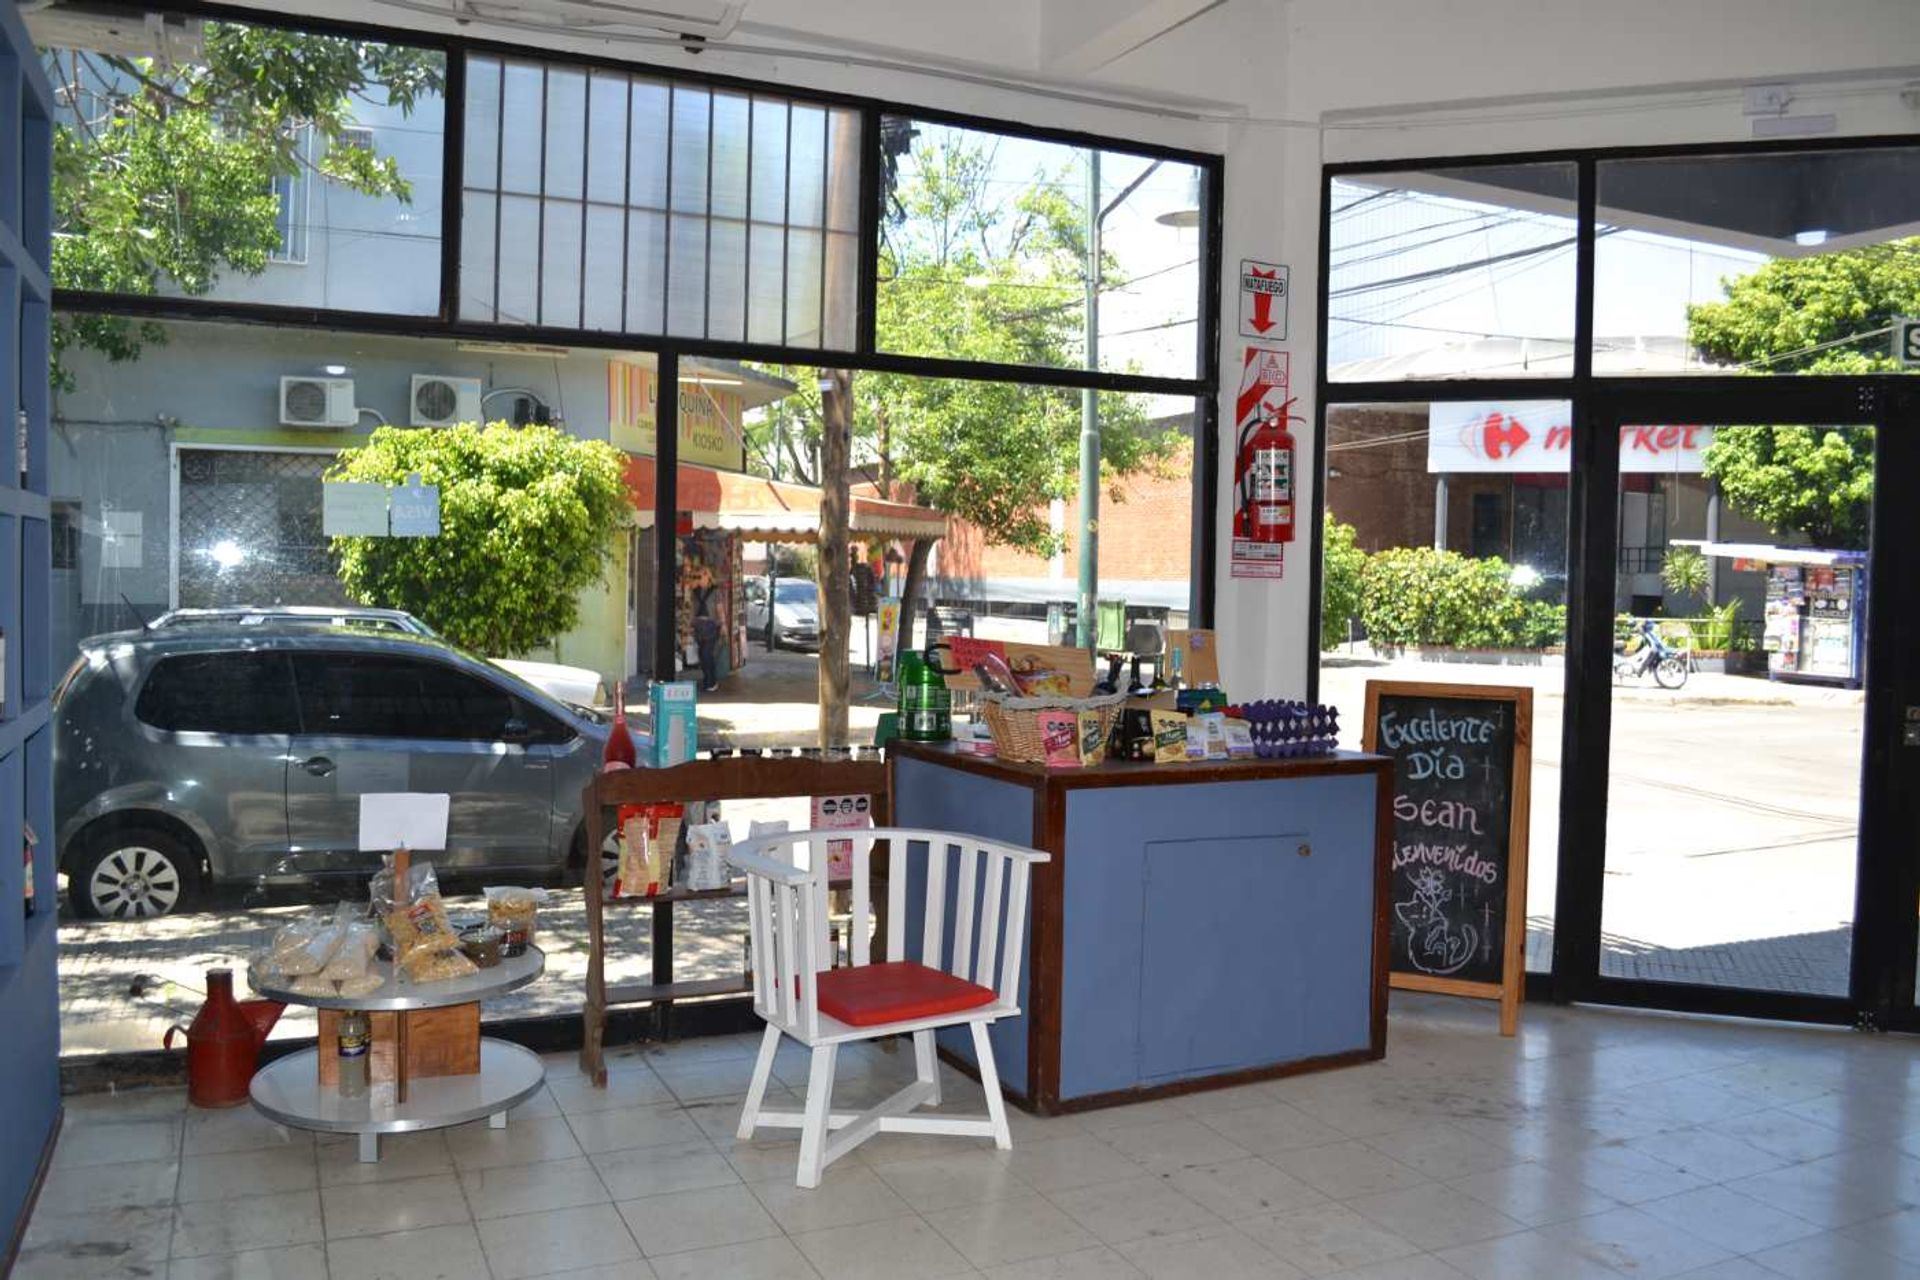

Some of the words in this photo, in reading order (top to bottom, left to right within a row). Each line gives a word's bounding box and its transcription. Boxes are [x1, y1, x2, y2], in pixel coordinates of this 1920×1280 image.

[1245, 277, 1284, 293] MATAFUEGO
[1543, 424, 1702, 455] mrket
[1391, 840, 1497, 884] ienvenidos
